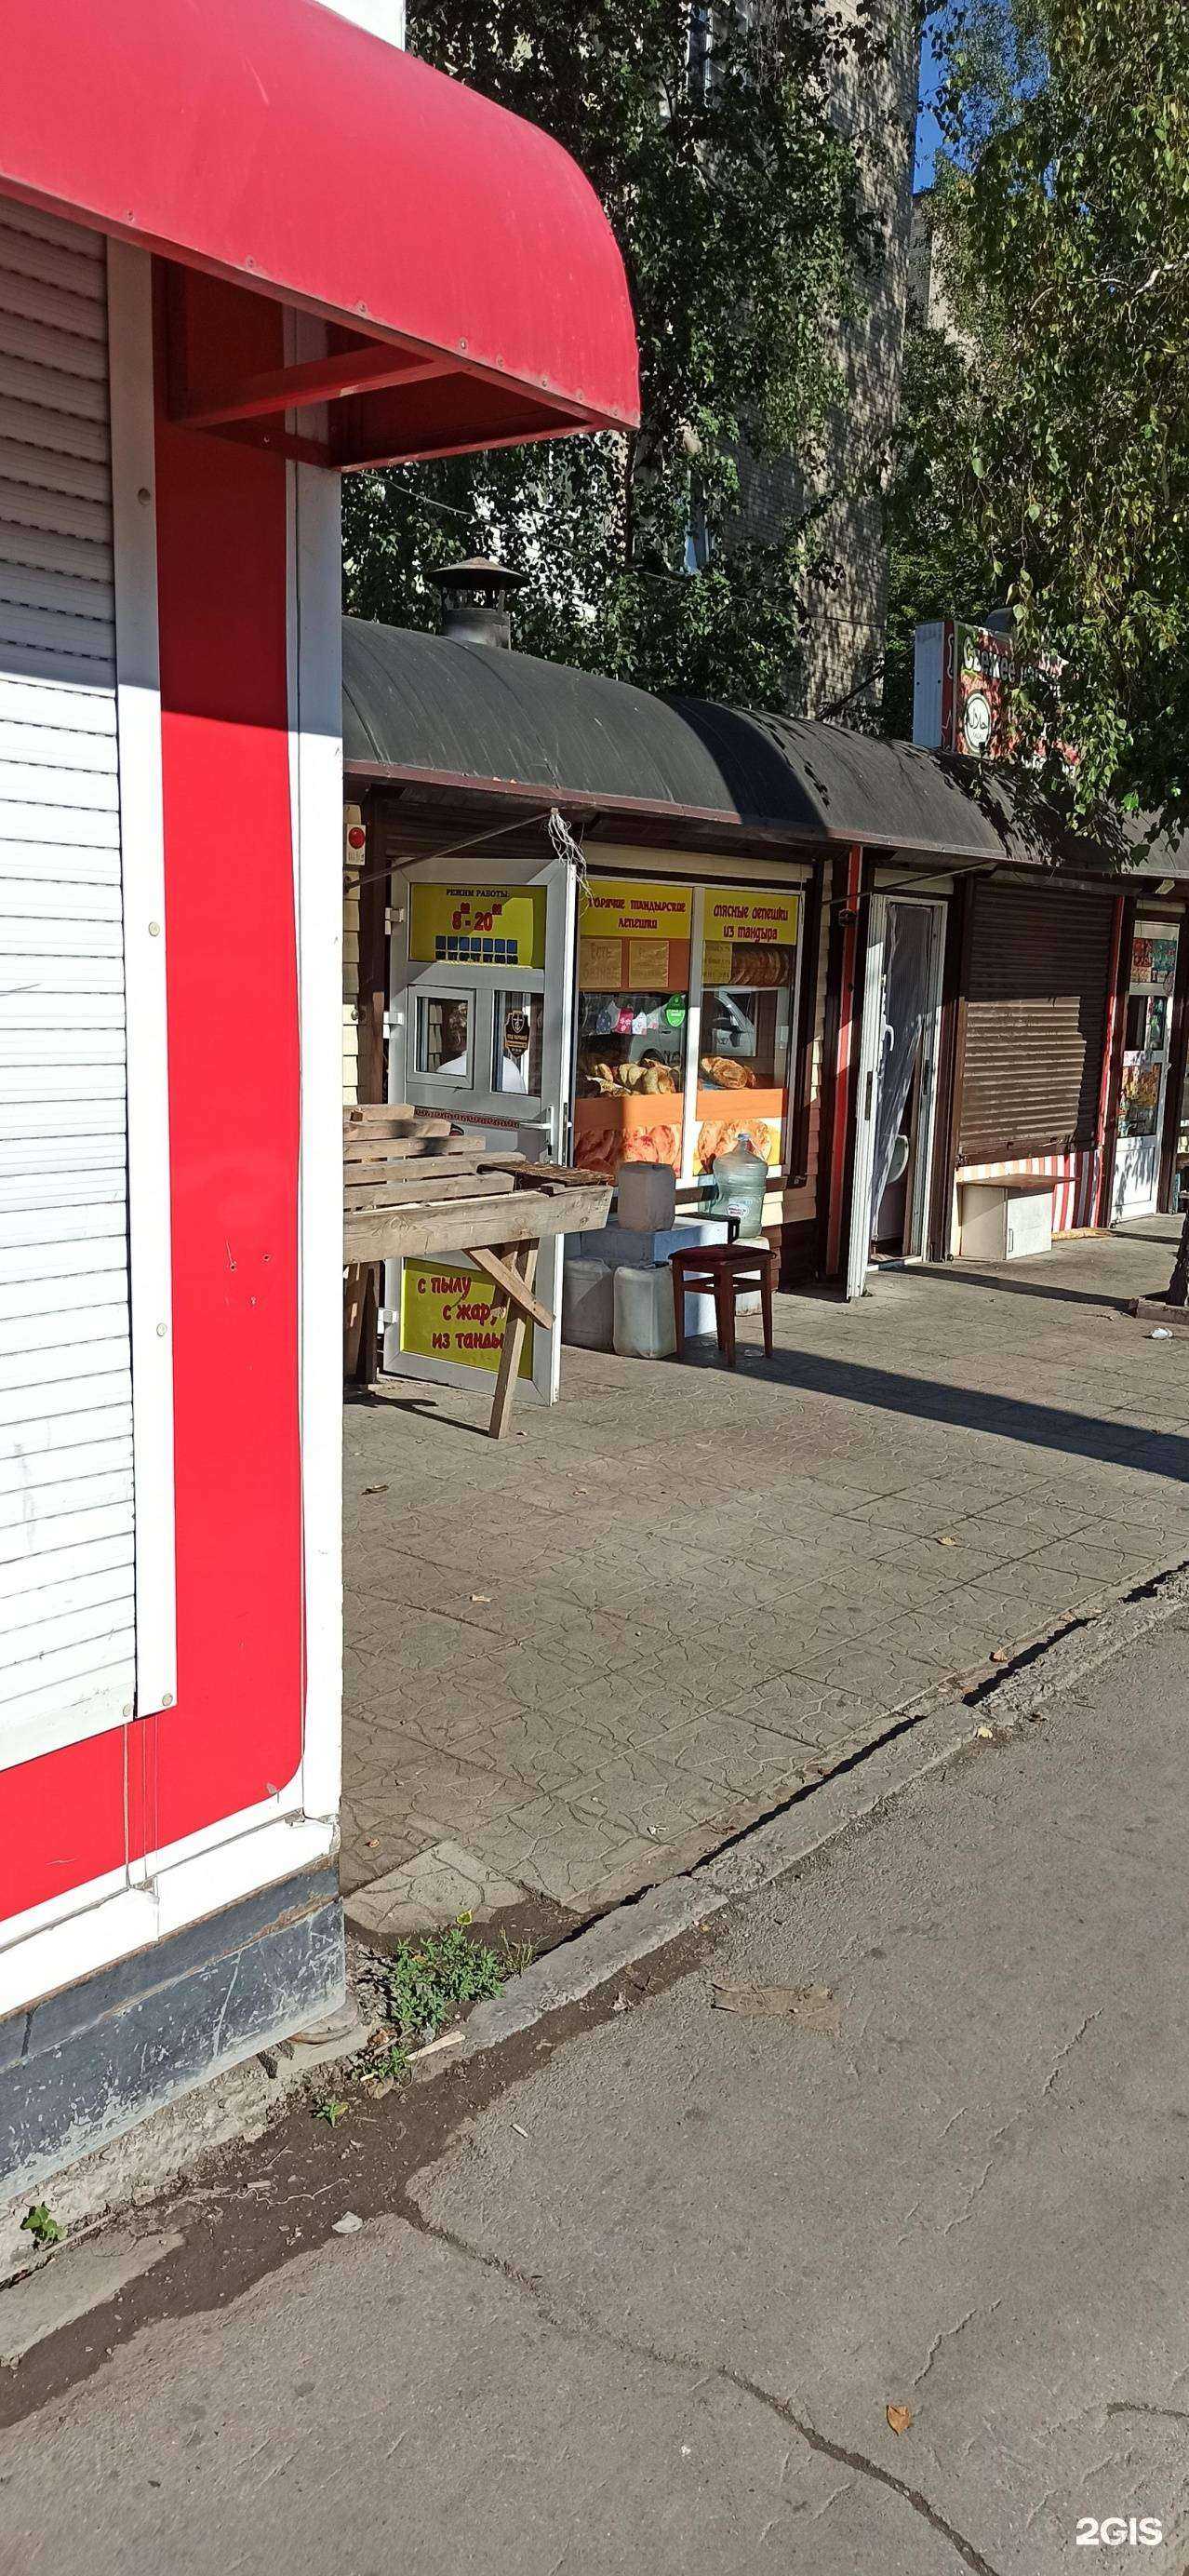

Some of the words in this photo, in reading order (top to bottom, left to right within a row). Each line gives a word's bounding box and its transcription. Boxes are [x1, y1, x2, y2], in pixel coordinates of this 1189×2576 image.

[447, 889, 474, 897] РЕЖИМ
[431, 1277, 472, 1300] пылу
[455, 1332, 504, 1349] танды
